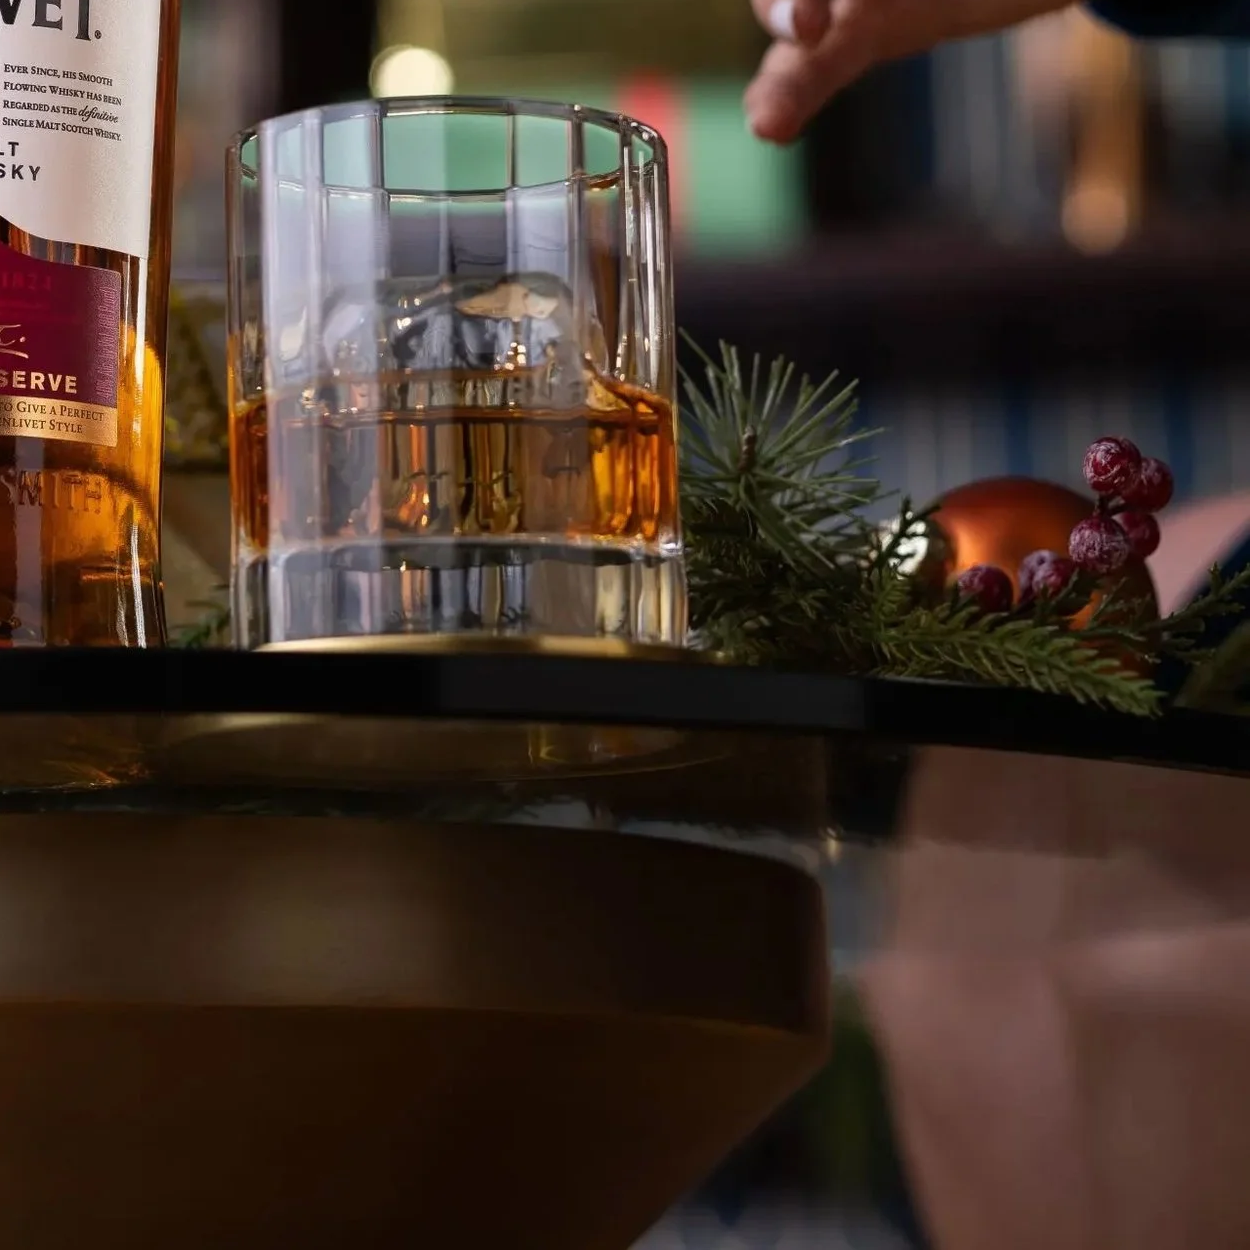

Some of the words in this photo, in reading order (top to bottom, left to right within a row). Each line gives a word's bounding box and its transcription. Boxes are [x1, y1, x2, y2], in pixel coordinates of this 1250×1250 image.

[3, 63, 29, 74] EVER
[30, 66, 60, 78] SINCE,
[62, 71, 76, 80] HIS
[78, 71, 113, 86] SMOOTH
[3, 81, 47, 94] FLOWING
[49, 85, 86, 98] WHISKY
[86, 92, 102, 102] HAS
[103, 95, 122, 106] BEEN
[3, 100, 50, 112] REGARDED
[50, 104, 61, 114] AS
[61, 106, 78, 116] THE
[78, 105, 119, 124] definitive
[2, 116, 35, 128] SINGLE
[35, 119, 61, 130] MALT
[61, 122, 93, 136] SCOTCH
[94, 127, 122, 142] WHISKY.
[16, 401, 47, 414] GIVE
[50, 405, 57, 415] A
[60, 404, 104, 422] PERFECT
[49, 419, 83, 434] STYLE
